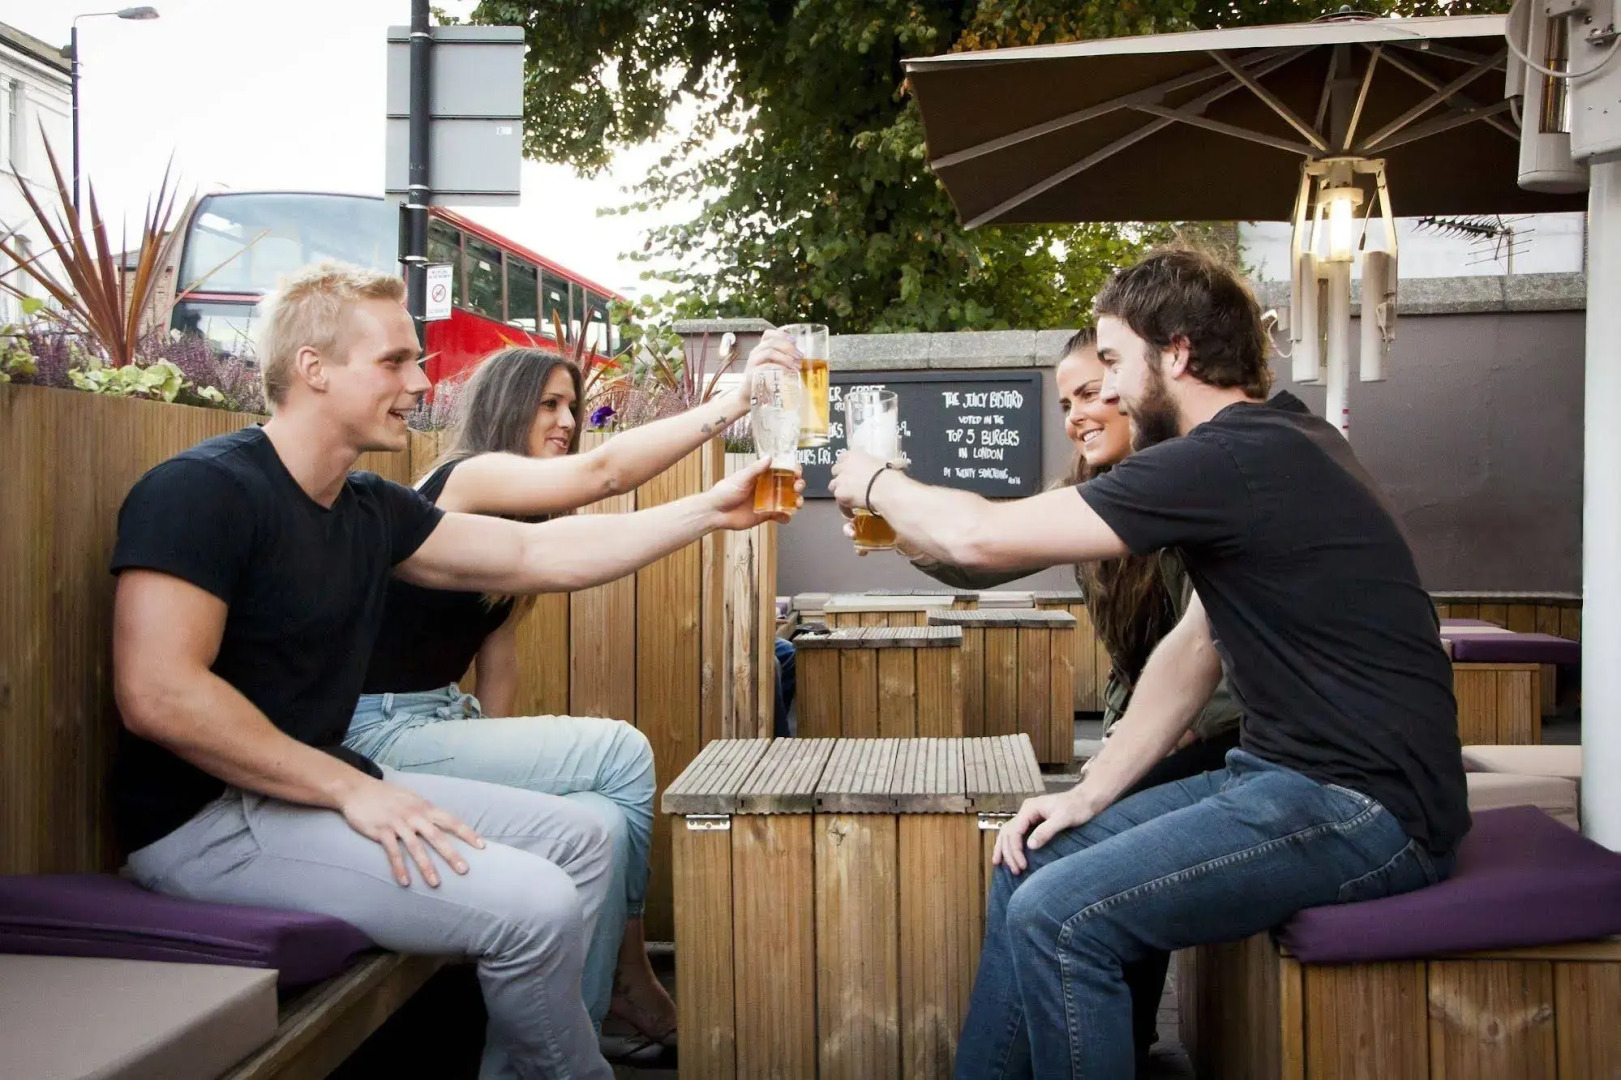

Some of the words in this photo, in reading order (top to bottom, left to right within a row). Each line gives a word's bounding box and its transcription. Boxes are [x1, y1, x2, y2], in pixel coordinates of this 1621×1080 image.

[962, 392, 988, 408] JUICY
[990, 390, 1024, 409] BASTARD
[958, 415, 982, 424] VOTED
[984, 415, 992, 424] IN
[946, 428, 964, 442] TOP
[966, 429, 975, 444] 5
[981, 428, 1019, 446] BURGERS
[958, 447, 967, 459] IN
[973, 446, 1004, 460] LONDON
